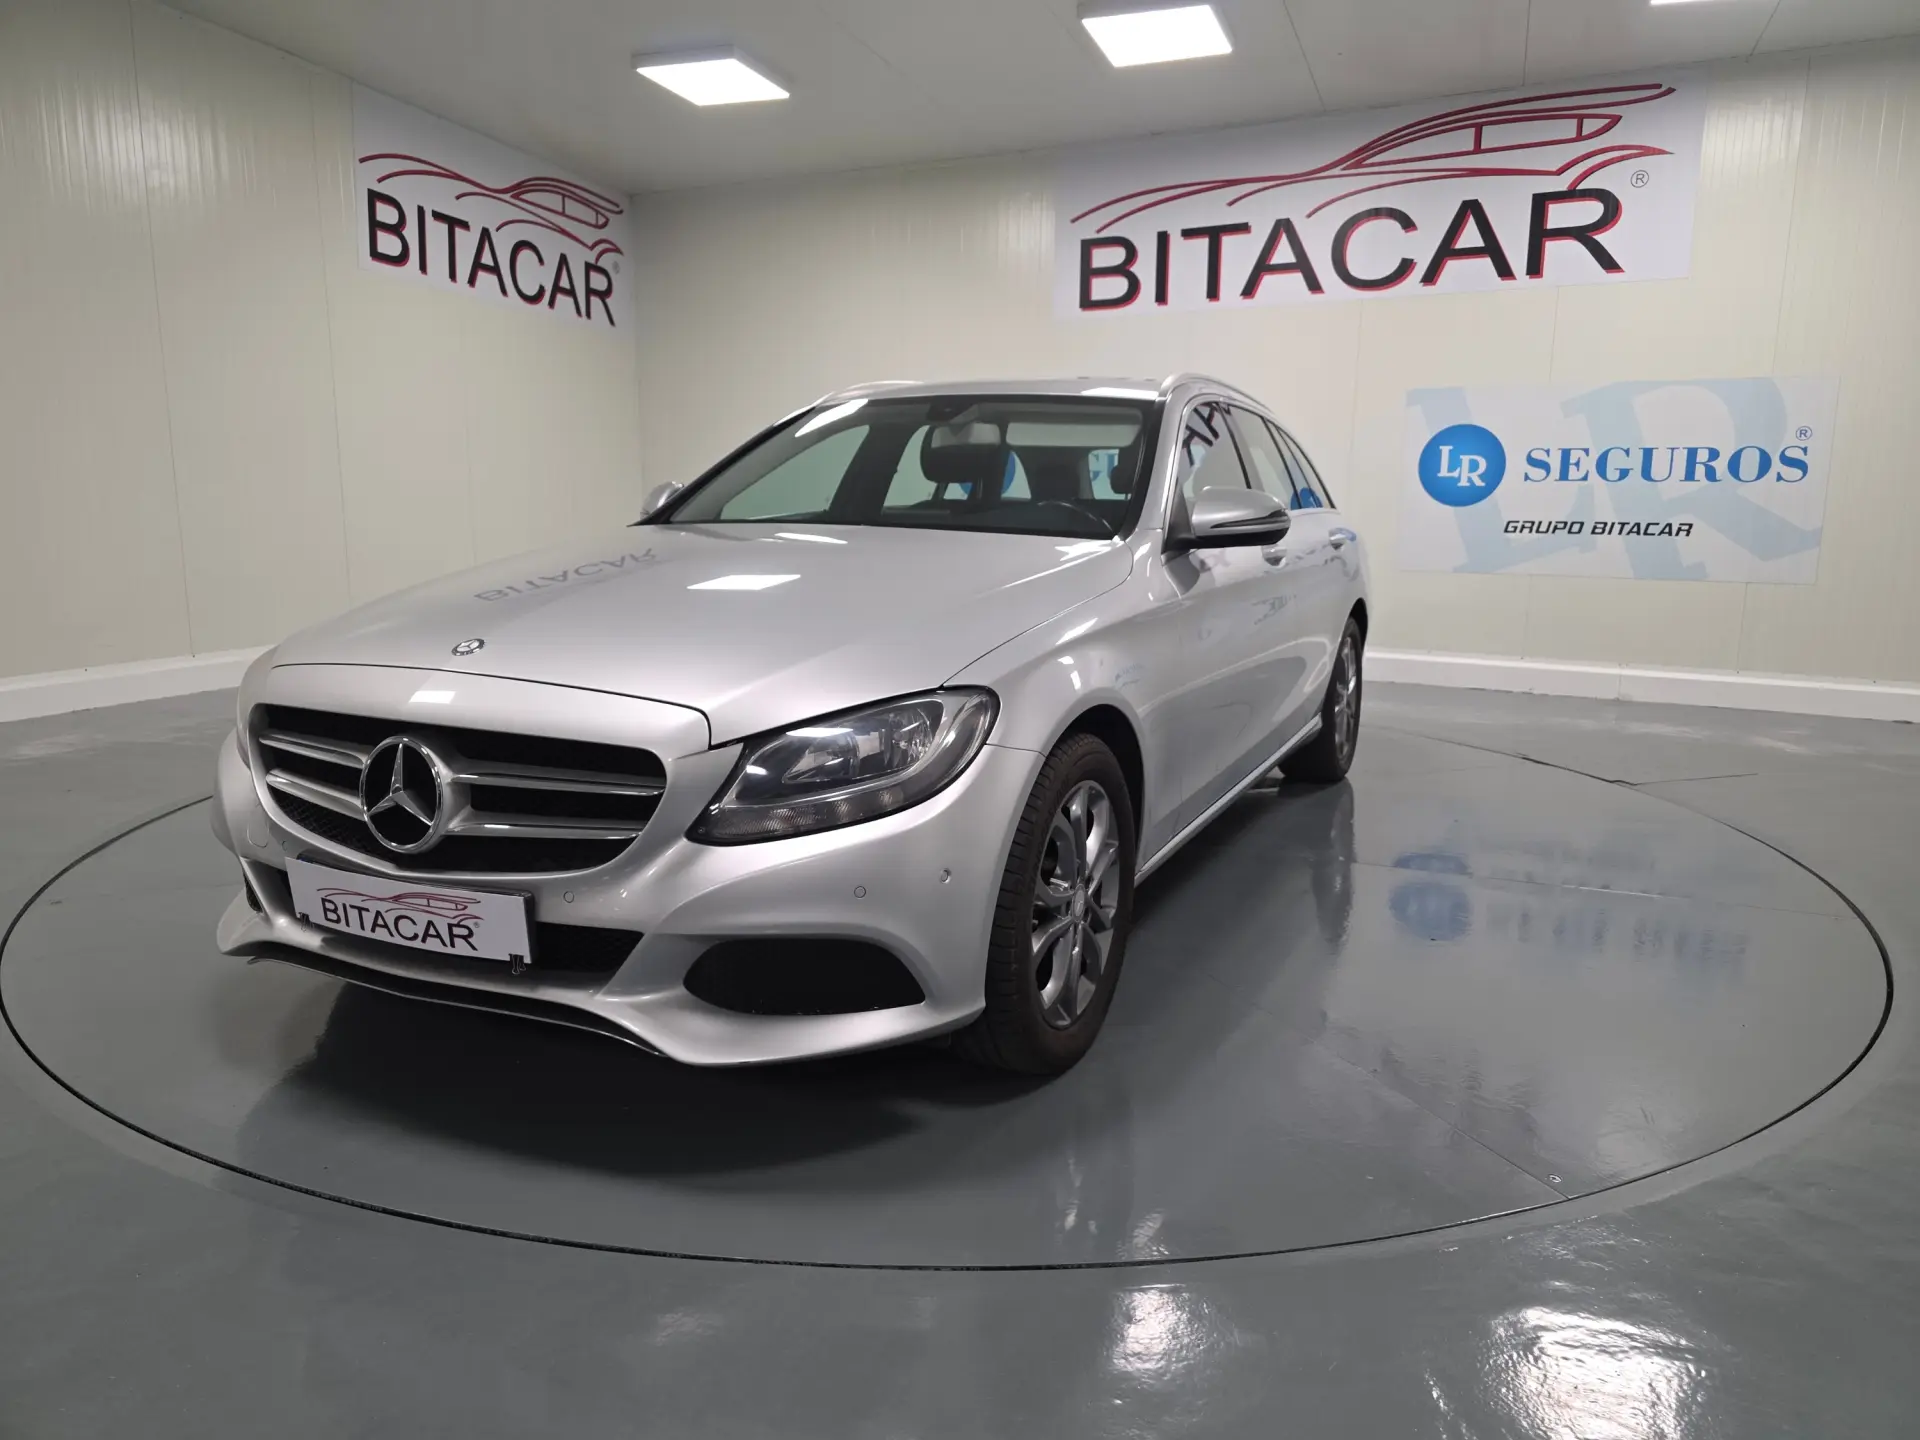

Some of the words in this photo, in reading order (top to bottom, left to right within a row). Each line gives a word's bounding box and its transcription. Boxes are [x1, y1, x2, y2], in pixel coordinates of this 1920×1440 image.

[367, 188, 616, 327] BITACAR
[1079, 187, 1625, 311] BITACAR
[1437, 445, 1488, 487] LR
[1523, 445, 1809, 483] SEGUROS
[1503, 520, 1586, 535] GRUPO
[1590, 520, 1694, 537] BITACAR
[320, 897, 479, 951] BITACAR
